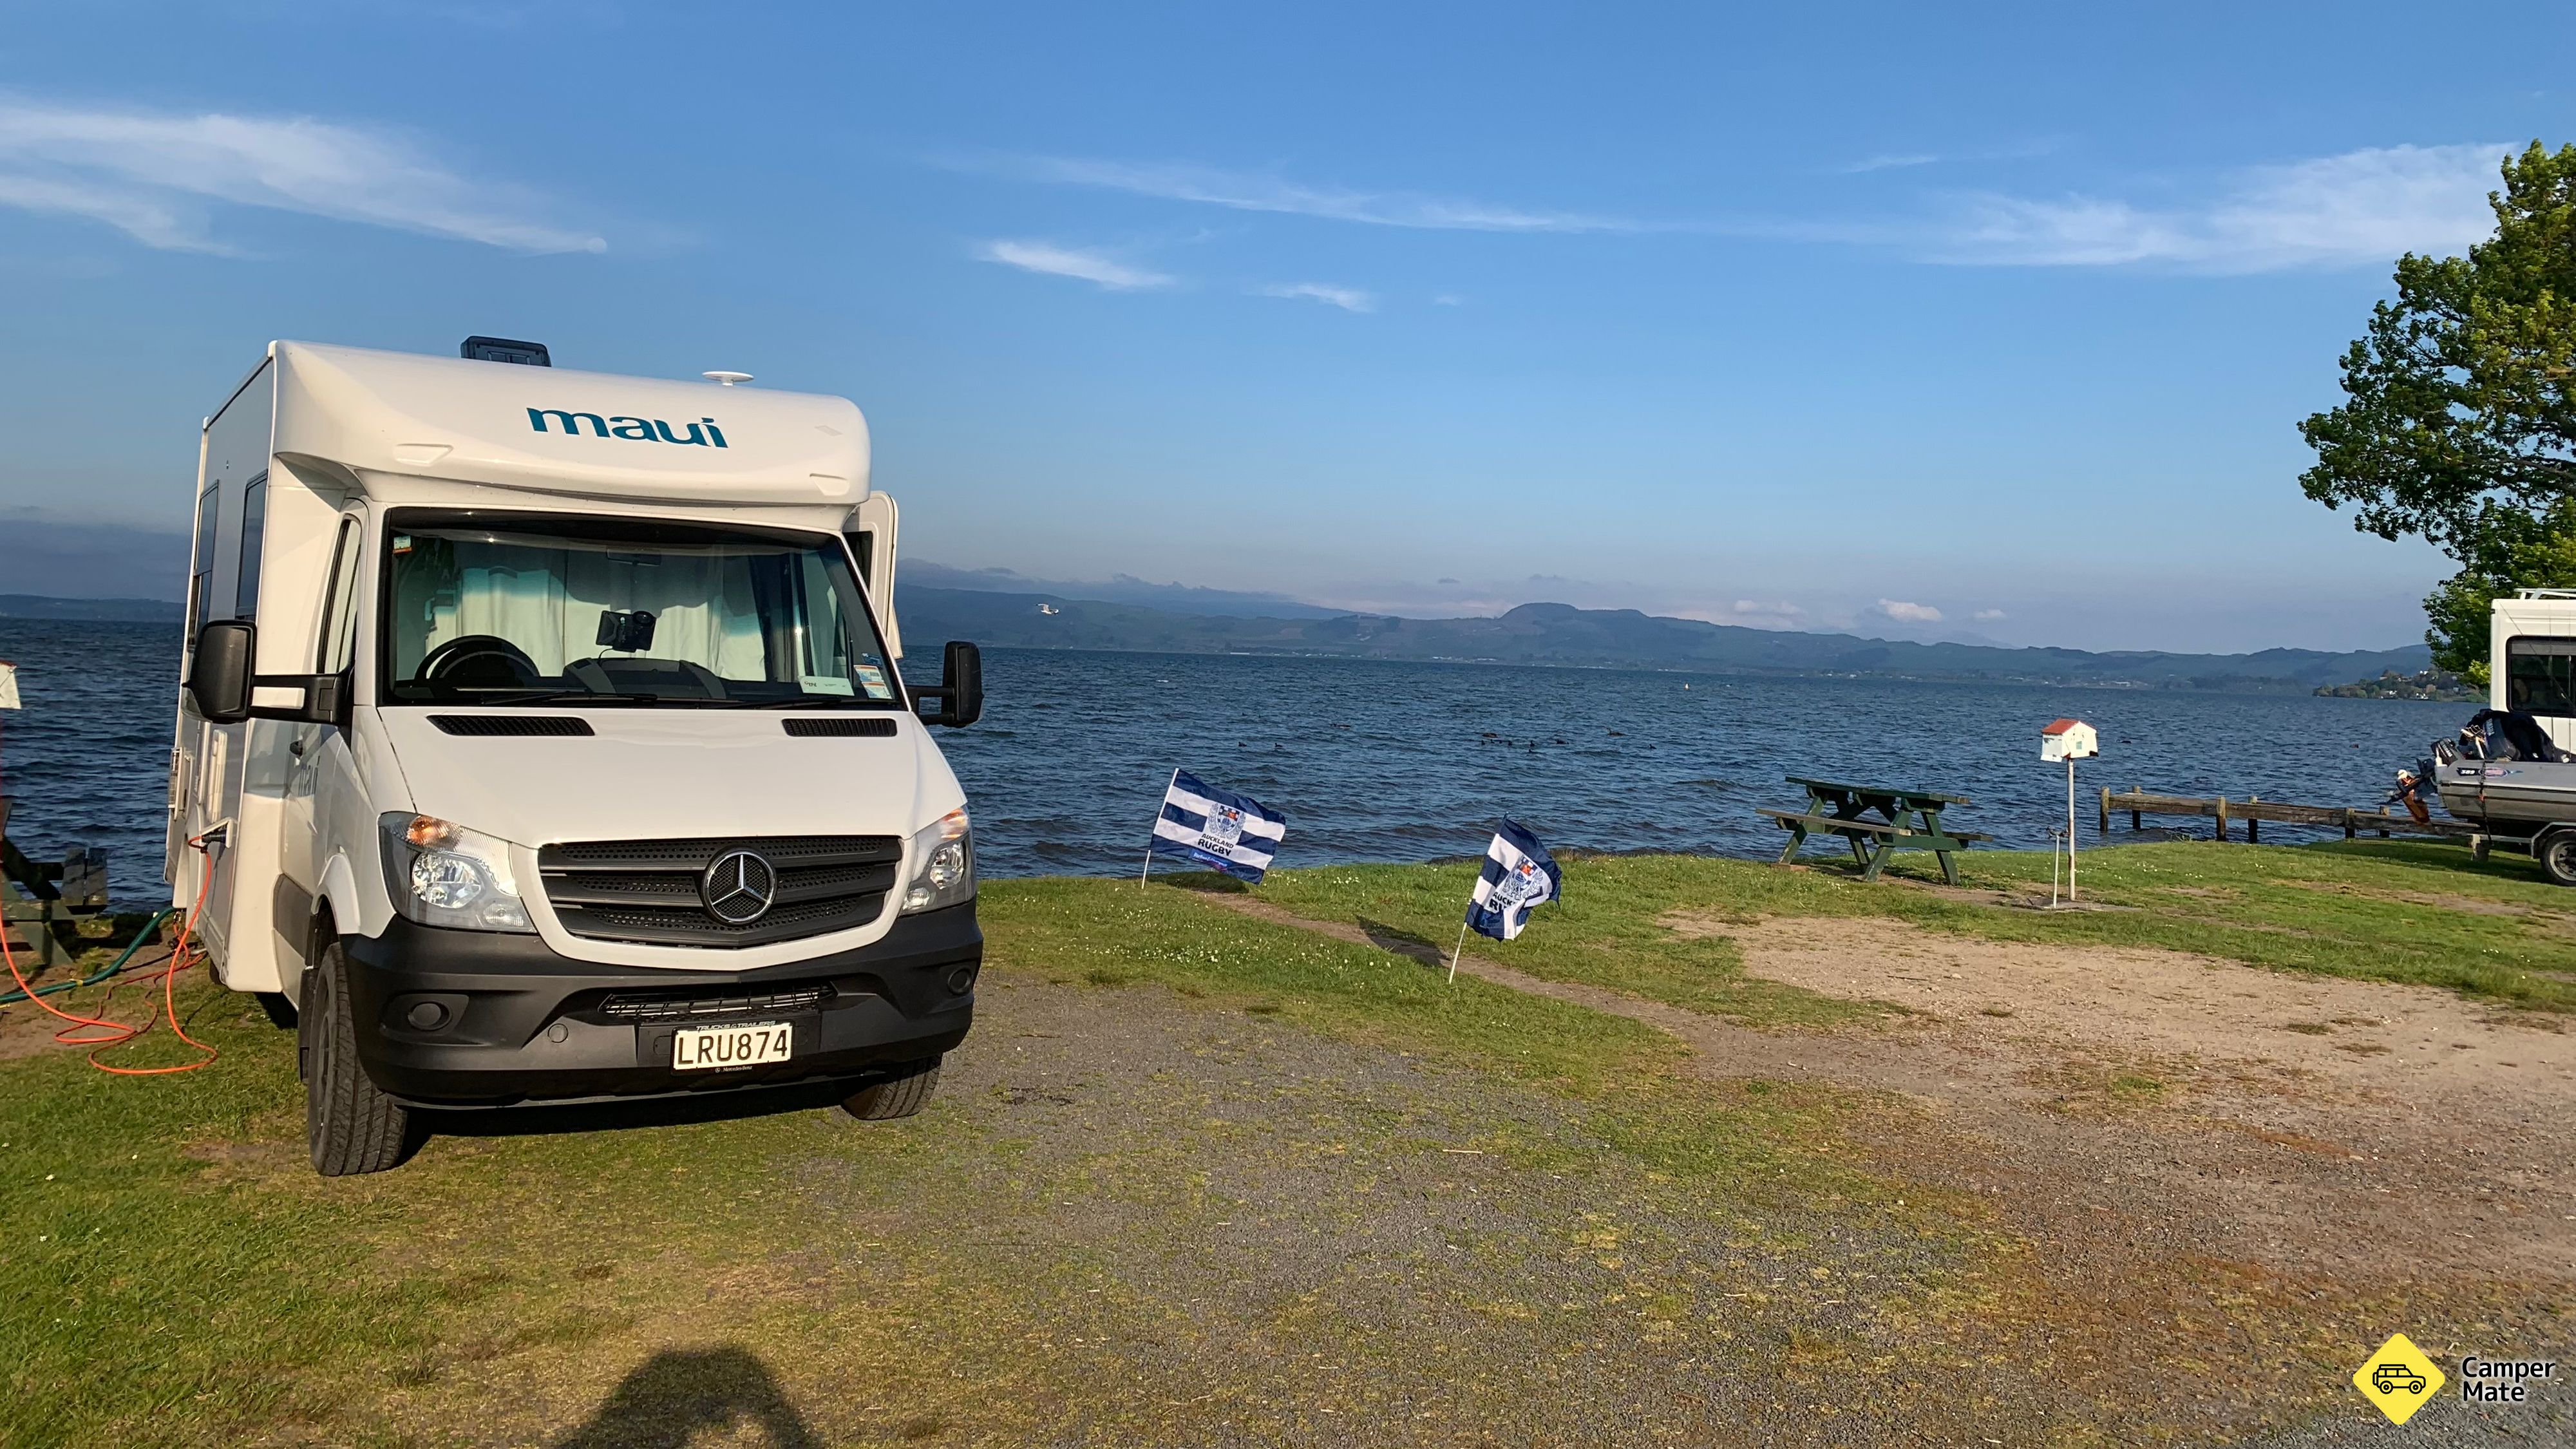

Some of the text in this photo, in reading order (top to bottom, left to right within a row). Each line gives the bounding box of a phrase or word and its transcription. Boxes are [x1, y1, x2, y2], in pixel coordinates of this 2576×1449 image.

[526, 408, 728, 448] maui
[1198, 838, 1231, 856] RUGBY
[1201, 833, 1234, 848] AUCKLAND
[1493, 892, 1512, 905] AUCK
[677, 1029, 788, 1065] LRU874
